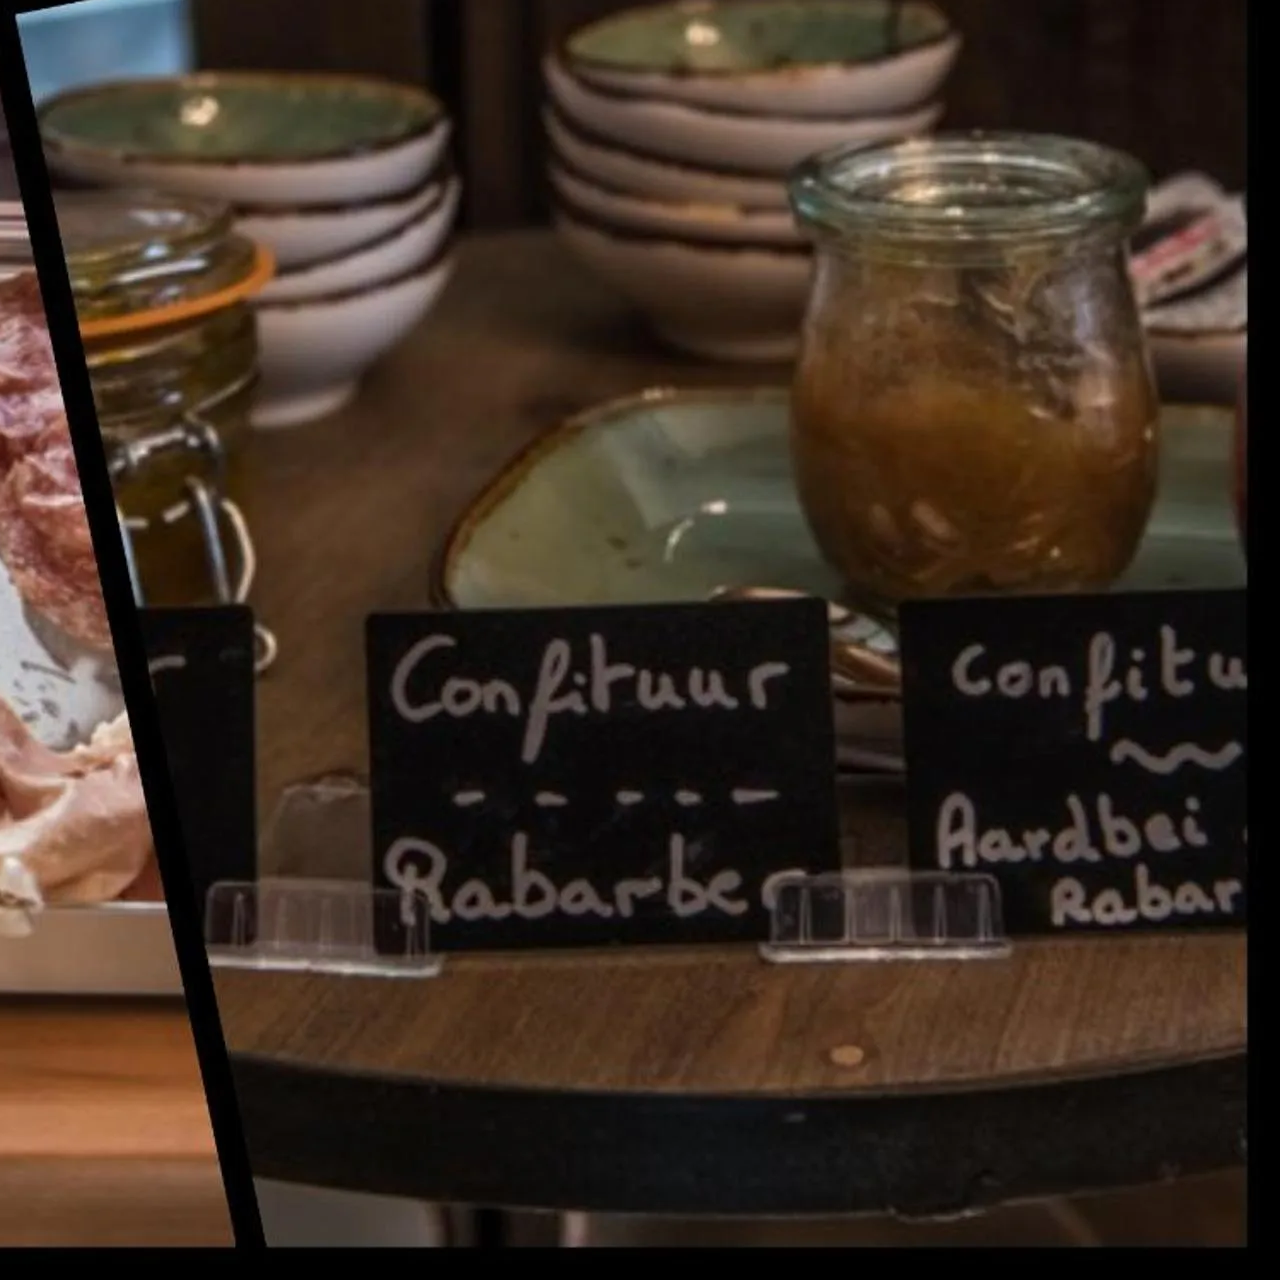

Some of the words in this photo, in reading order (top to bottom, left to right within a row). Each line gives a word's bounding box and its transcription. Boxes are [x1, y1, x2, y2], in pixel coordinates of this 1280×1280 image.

[390, 632, 790, 764] Confituur
[951, 623, 1247, 742] Confitu
[383, 830, 809, 927] Rabarber
[937, 791, 1208, 869] Aardbei
[1050, 862, 1242, 927] Rabar
